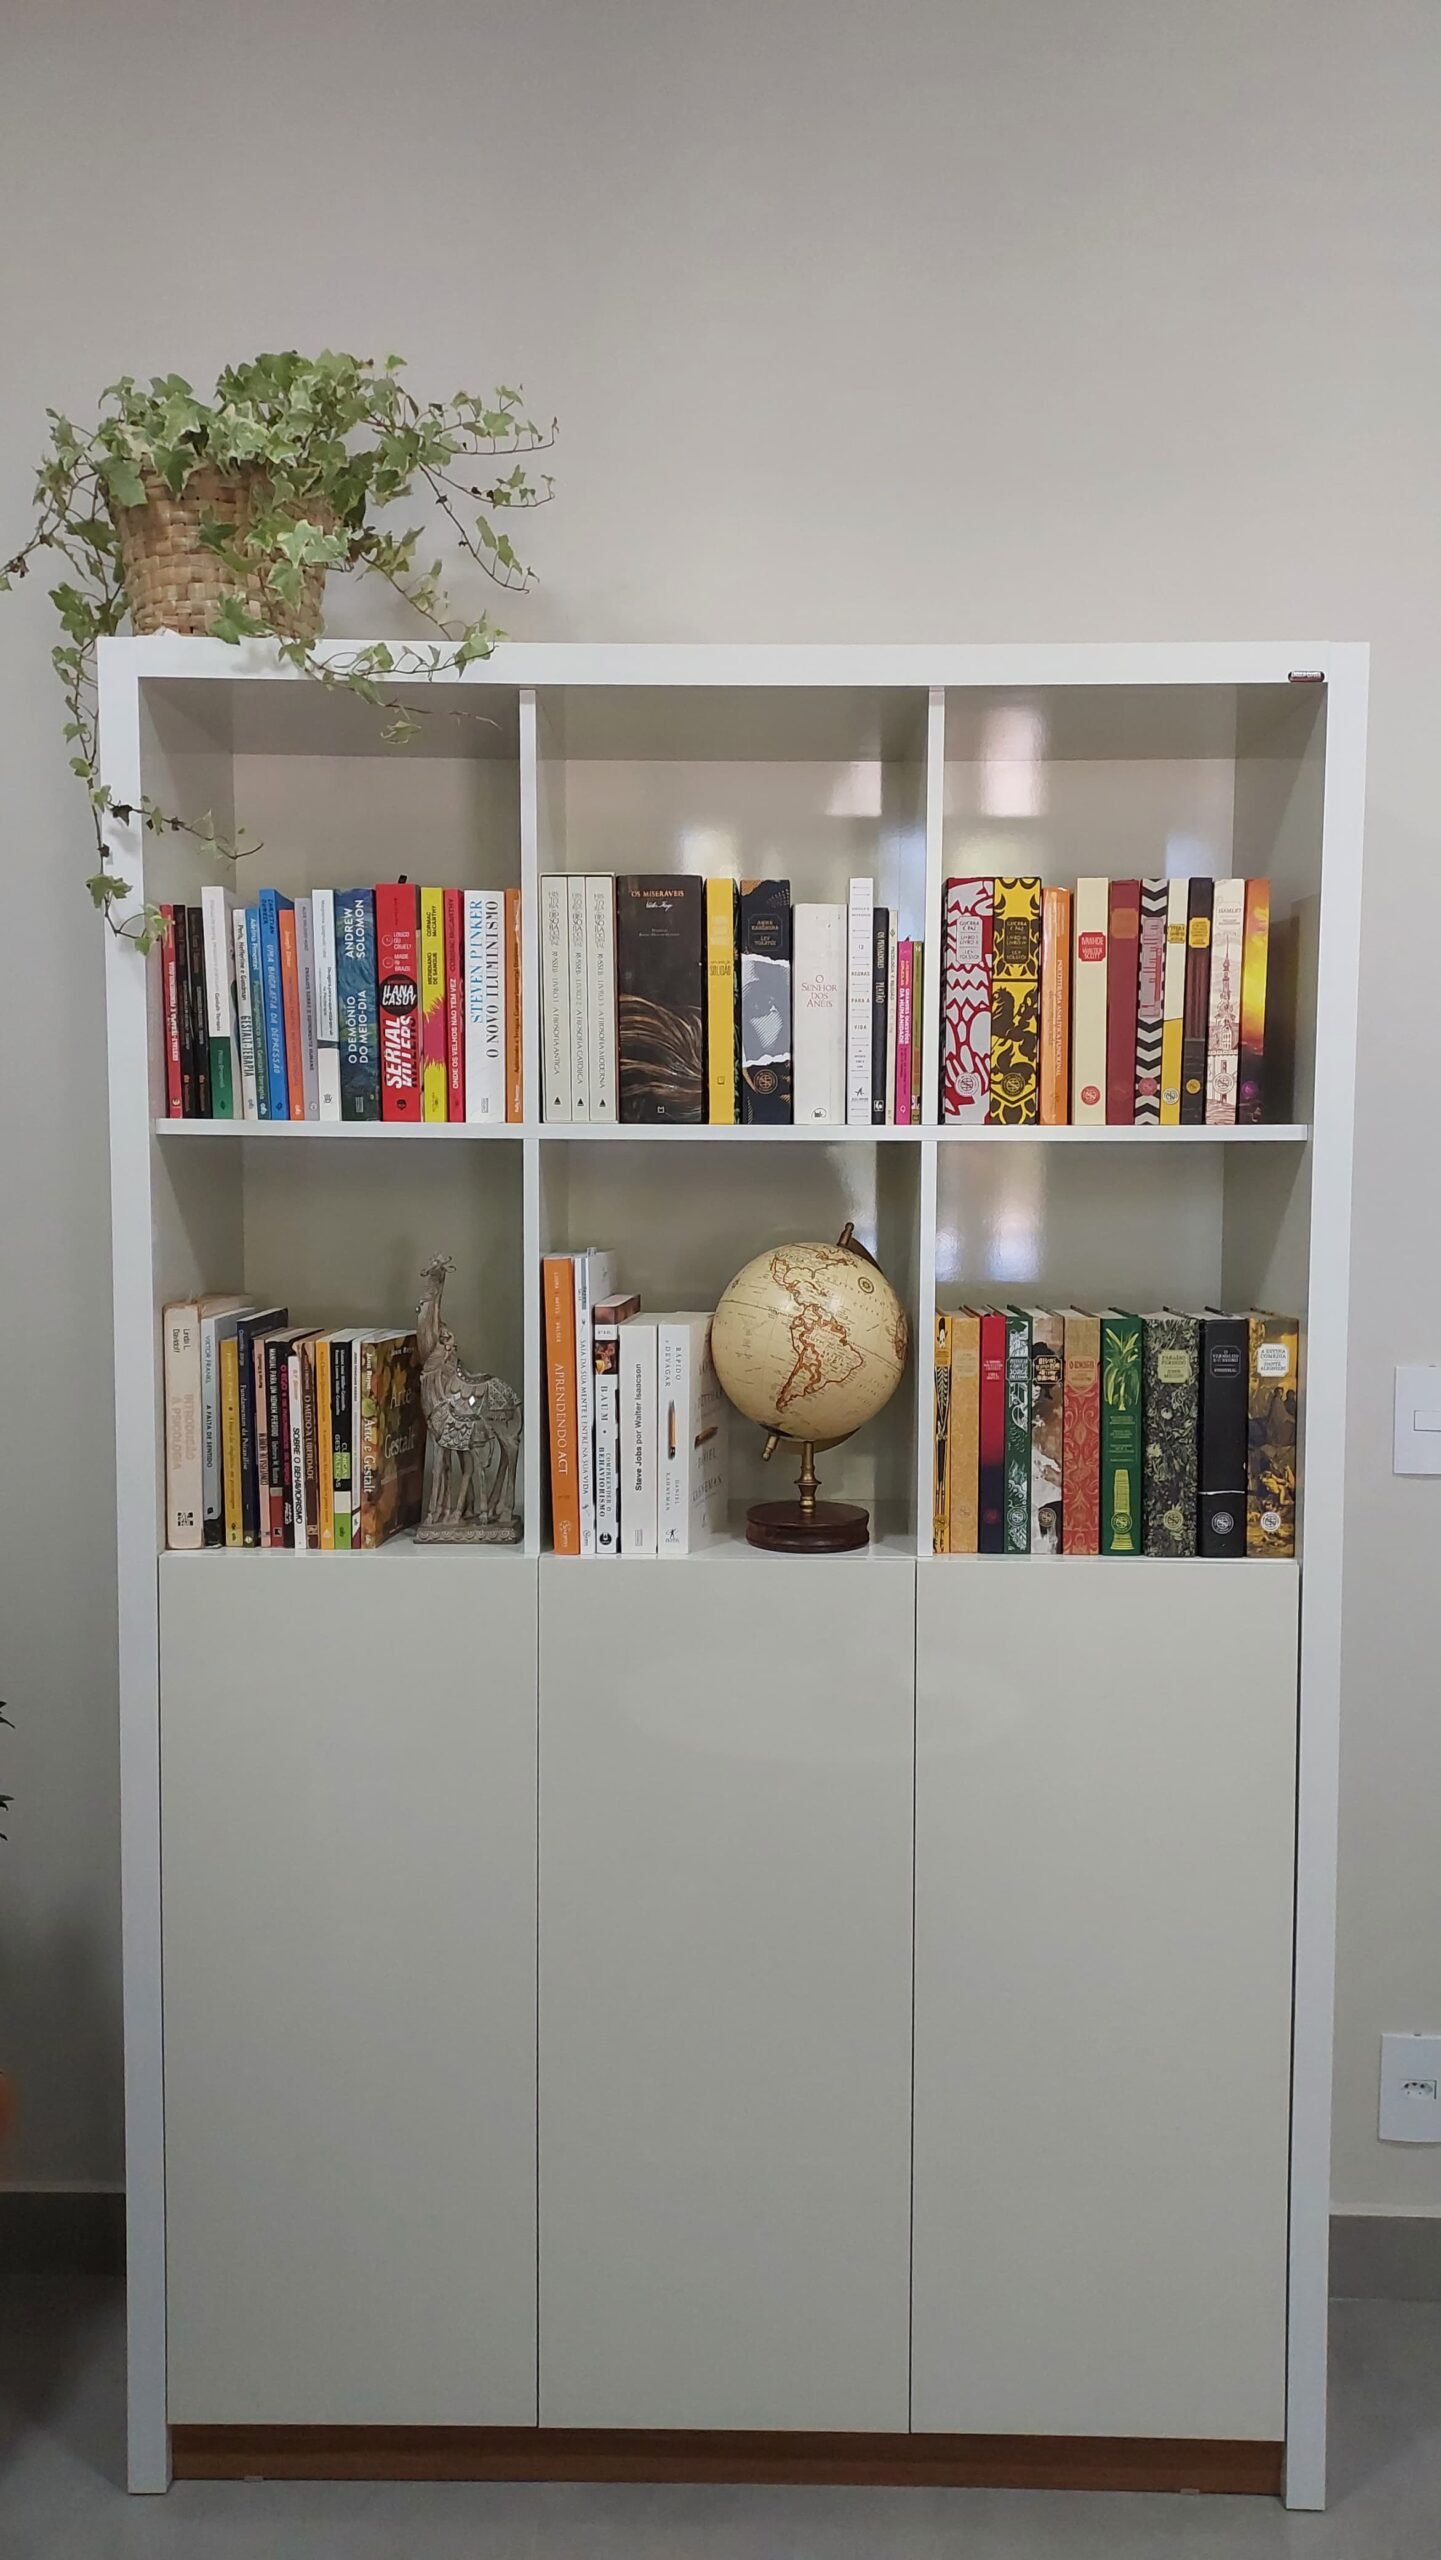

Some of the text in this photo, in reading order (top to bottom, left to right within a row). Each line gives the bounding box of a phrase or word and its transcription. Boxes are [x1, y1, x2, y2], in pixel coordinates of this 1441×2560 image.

[631, 888, 685, 898] OS MISERÁVEIS
[343, 908, 355, 960] ANDREW
[354, 899, 366, 960] SOLOMON
[469, 900, 484, 1024] STEVEN PINKER
[267, 965, 278, 1009] BIOGRAFIA
[383, 984, 417, 996] ILANA
[449, 978, 457, 994] VEZ
[485, 900, 499, 1058] O NOVO ILUMINISMO
[801, 982, 838, 992] SENHOR
[815, 974, 824, 984] O
[382, 994, 418, 1006] CASOY
[875, 982, 887, 1004] PLATÃO
[343, 996, 359, 1065] O DEMÔNIO
[358, 990, 369, 1064] DO MEIO-DIA
[240, 1015, 255, 1078] GESTALT-TERAPIA
[384, 1017, 403, 1090] SERIAL
[399, 1015, 419, 1090] KILLERS
[451, 1057, 458, 1067] OS
[598, 1050, 606, 1088] MODERNA
[451, 1067, 459, 1089] ONDE
[182, 1328, 191, 1344] Linda
[580, 1339, 588, 1358] SAIA
[268, 1348, 277, 1369] MANUAL
[581, 1358, 588, 1369] DA
[663, 1345, 673, 1388] DEVAGAR
[675, 1346, 685, 1381] RÁPIDO
[270, 1385, 277, 1394] UM
[304, 1394, 311, 1402] O
[389, 1387, 413, 1410] Arte
[270, 1394, 278, 1414] HOMEM
[304, 1403, 312, 1427] MEDO
[600, 1385, 610, 1422] BAUM
[184, 1393, 197, 1461] INTRODUÇÃO
[271, 1414, 279, 1437] PERDIDO
[363, 1417, 377, 1442] Arte
[555, 1362, 568, 1476] APRENDENDO ACT
[634, 1363, 645, 1492] Steve Jobs por Walter Isaacson
[171, 1406, 182, 1470] PSICOLOGIA
[206, 1431, 213, 1440] DE
[384, 1426, 415, 1459] Gestalt
[581, 1421, 590, 1444] ENTRE
[206, 1440, 214, 1468] SENTIDO
[305, 1437, 314, 1480] LIBERDADE
[582, 1447, 589, 1458] NA
[292, 1427, 303, 1525] SOBRE O BEHAVIORISMO
[362, 1454, 377, 1494] Gestalt
[582, 1459, 590, 1474] SUA
[582, 1474, 590, 1495] VIDA
[598, 1446, 607, 1518] BEHAVIORISMO
